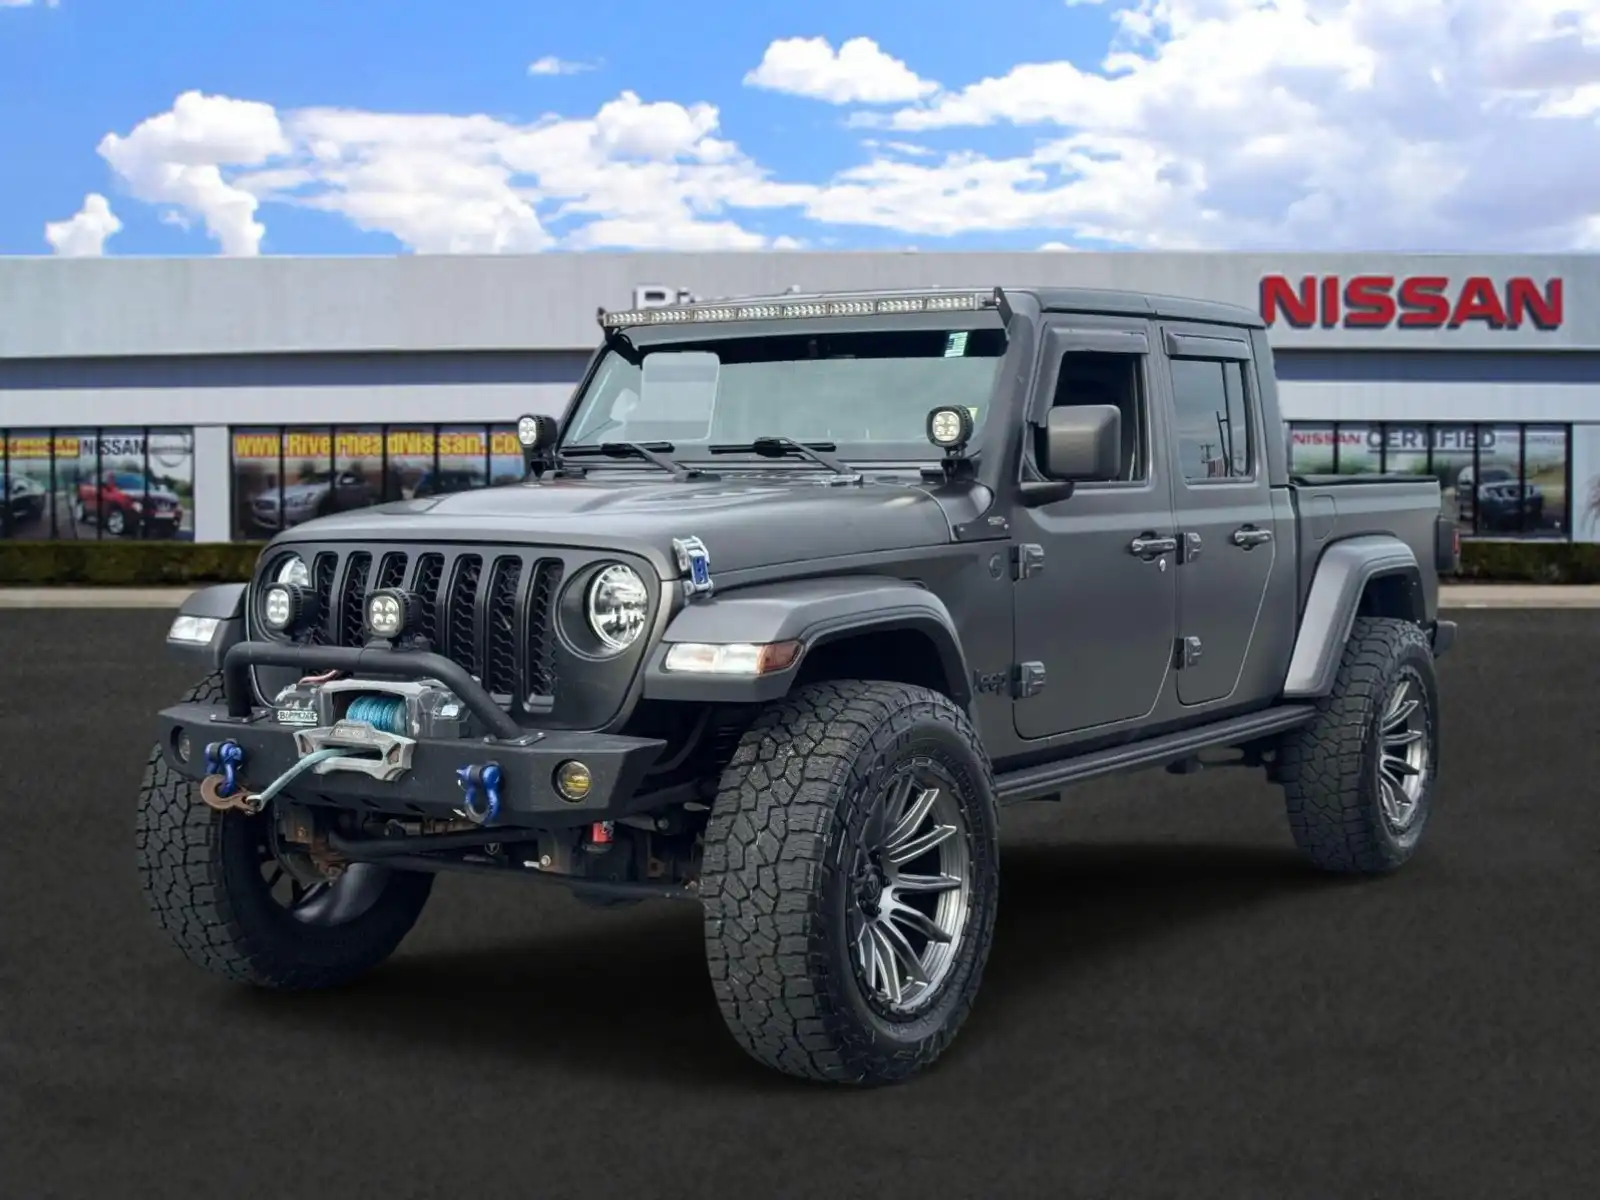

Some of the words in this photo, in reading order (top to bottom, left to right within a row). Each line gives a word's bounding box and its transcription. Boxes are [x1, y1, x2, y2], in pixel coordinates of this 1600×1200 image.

[1260, 275, 1563, 329] NISSAN
[82, 439, 147, 456] NISSAN
[234, 433, 522, 457] www.RiverheadNissan.co
[1292, 433, 1361, 445] NISSAN
[1366, 428, 1497, 449] CERTIFIED
